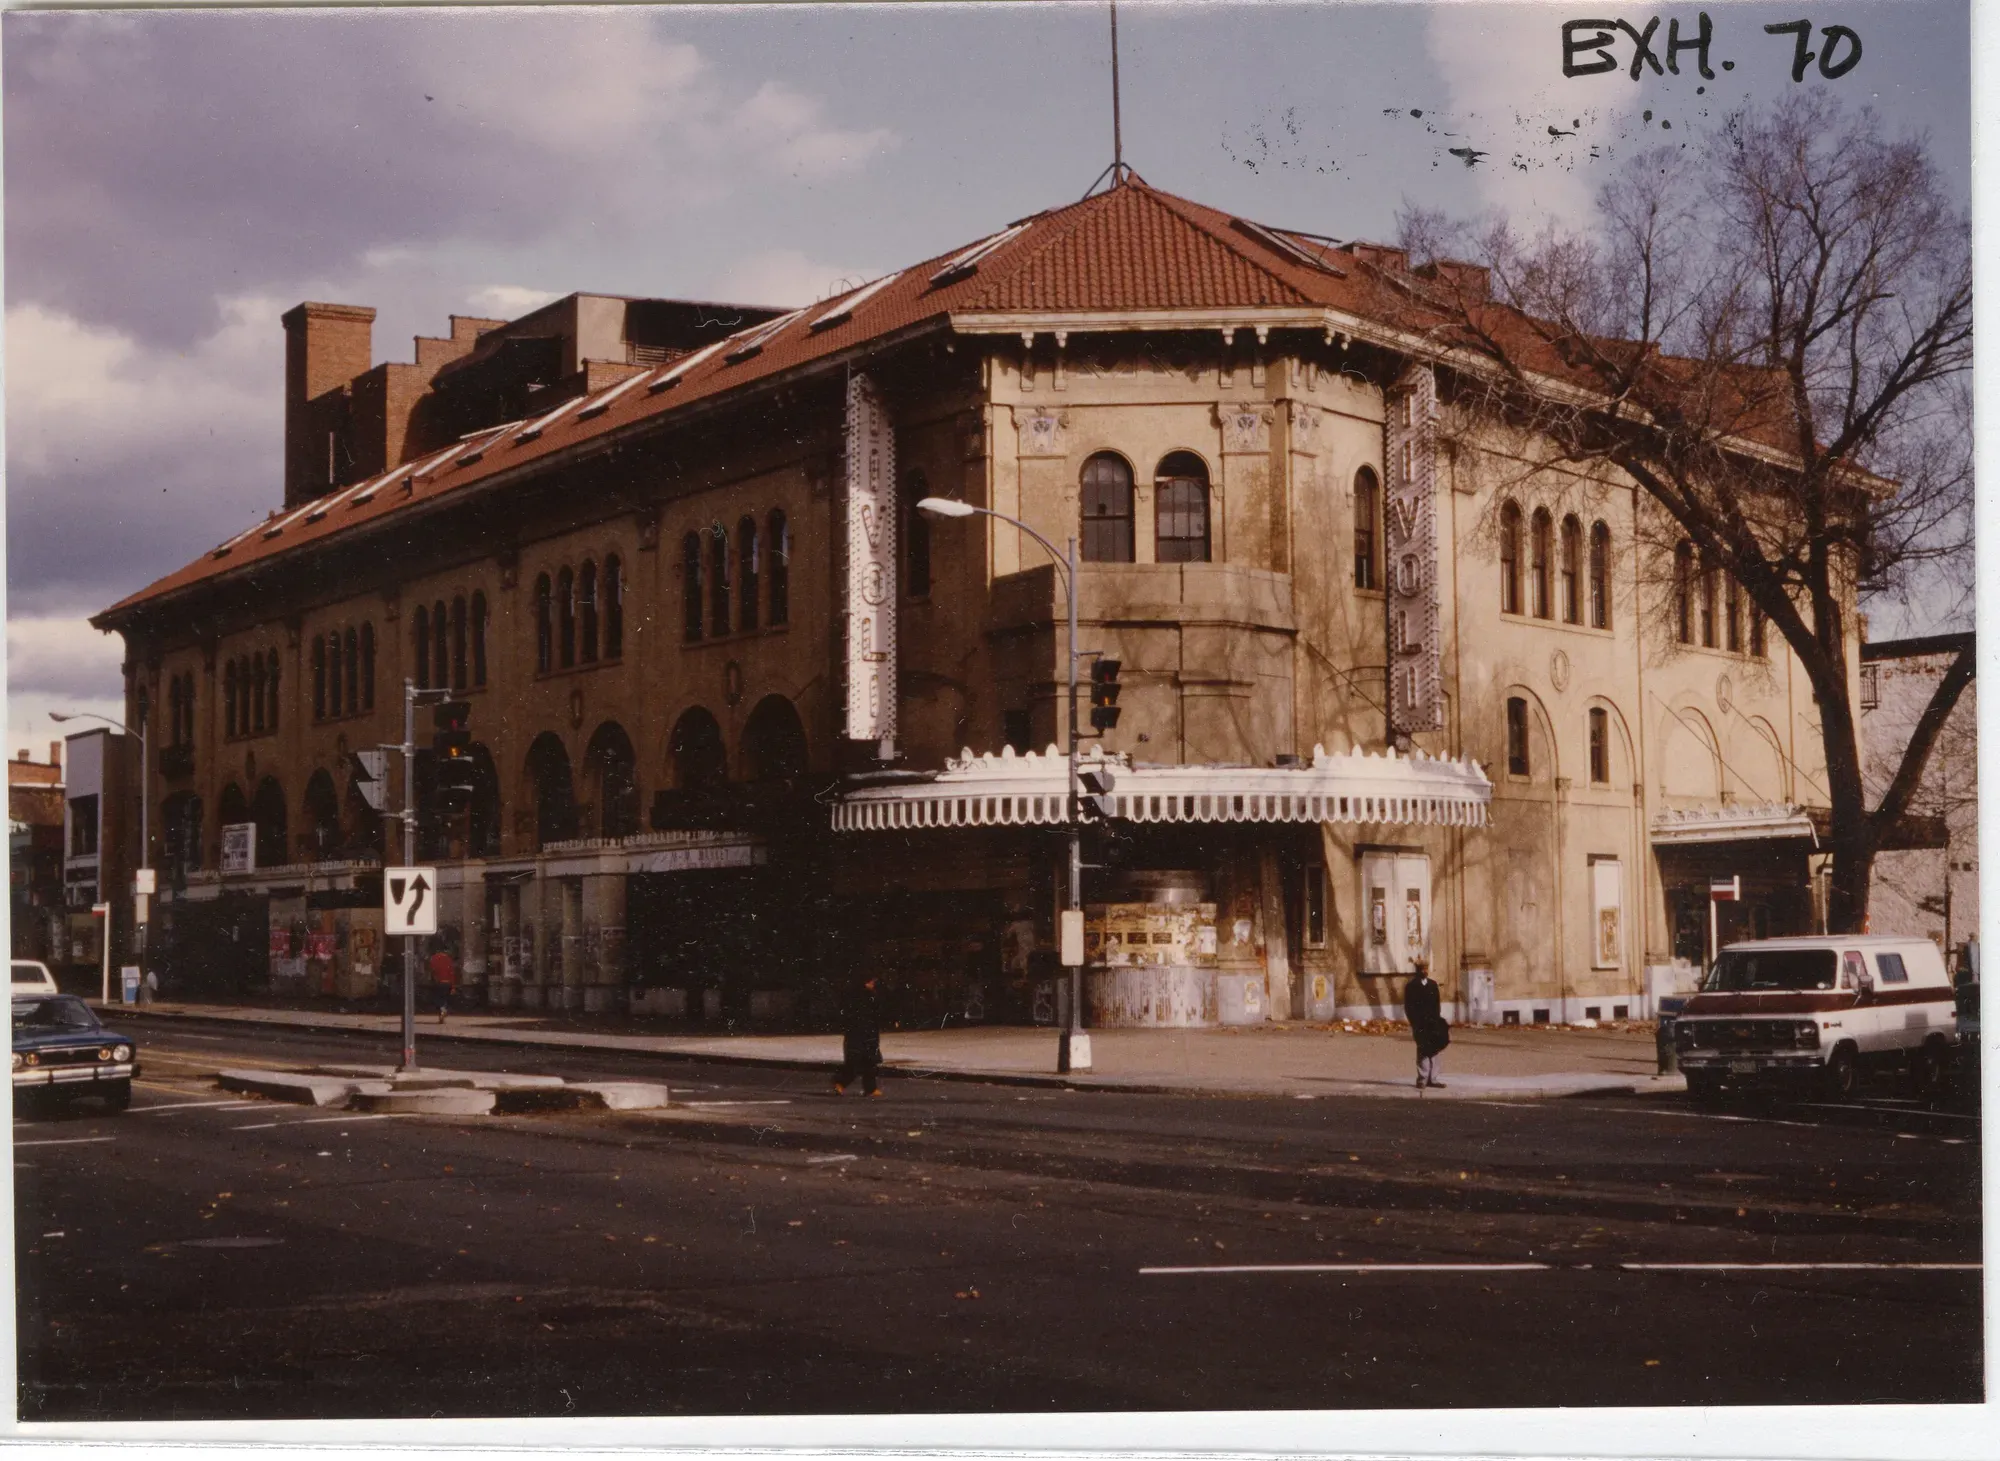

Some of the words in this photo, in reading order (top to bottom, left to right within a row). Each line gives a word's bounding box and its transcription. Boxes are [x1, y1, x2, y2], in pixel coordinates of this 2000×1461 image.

[1562, 11, 1735, 82] EXH.
[1764, 18, 1863, 83] 70
[1396, 383, 1423, 711] TIVOLI
